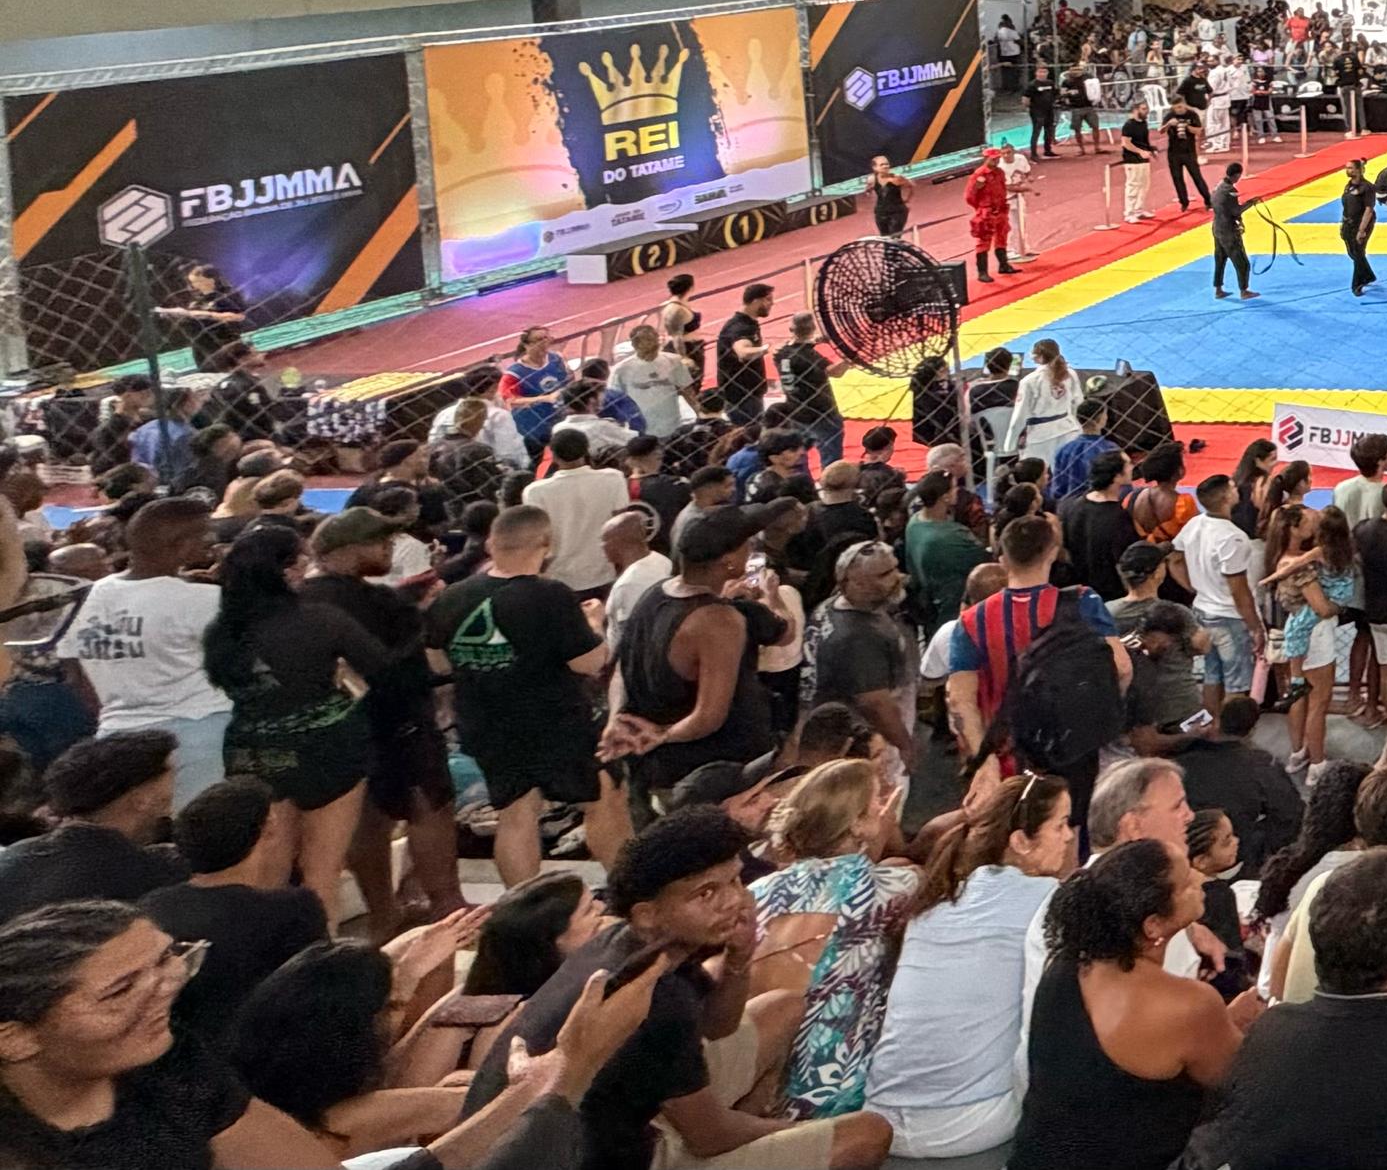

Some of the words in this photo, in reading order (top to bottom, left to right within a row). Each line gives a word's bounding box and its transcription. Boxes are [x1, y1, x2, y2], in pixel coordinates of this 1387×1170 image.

[877, 59, 956, 90] FBJJMMA
[605, 121, 680, 161] REI
[603, 167, 627, 185] DO
[630, 155, 686, 179] TATAME
[180, 161, 363, 218] FBJJMMA
[740, 214, 750, 232] 1
[819, 207, 829, 221] 3
[648, 248, 661, 268] 2
[1309, 426, 1365, 447] FBJJM
